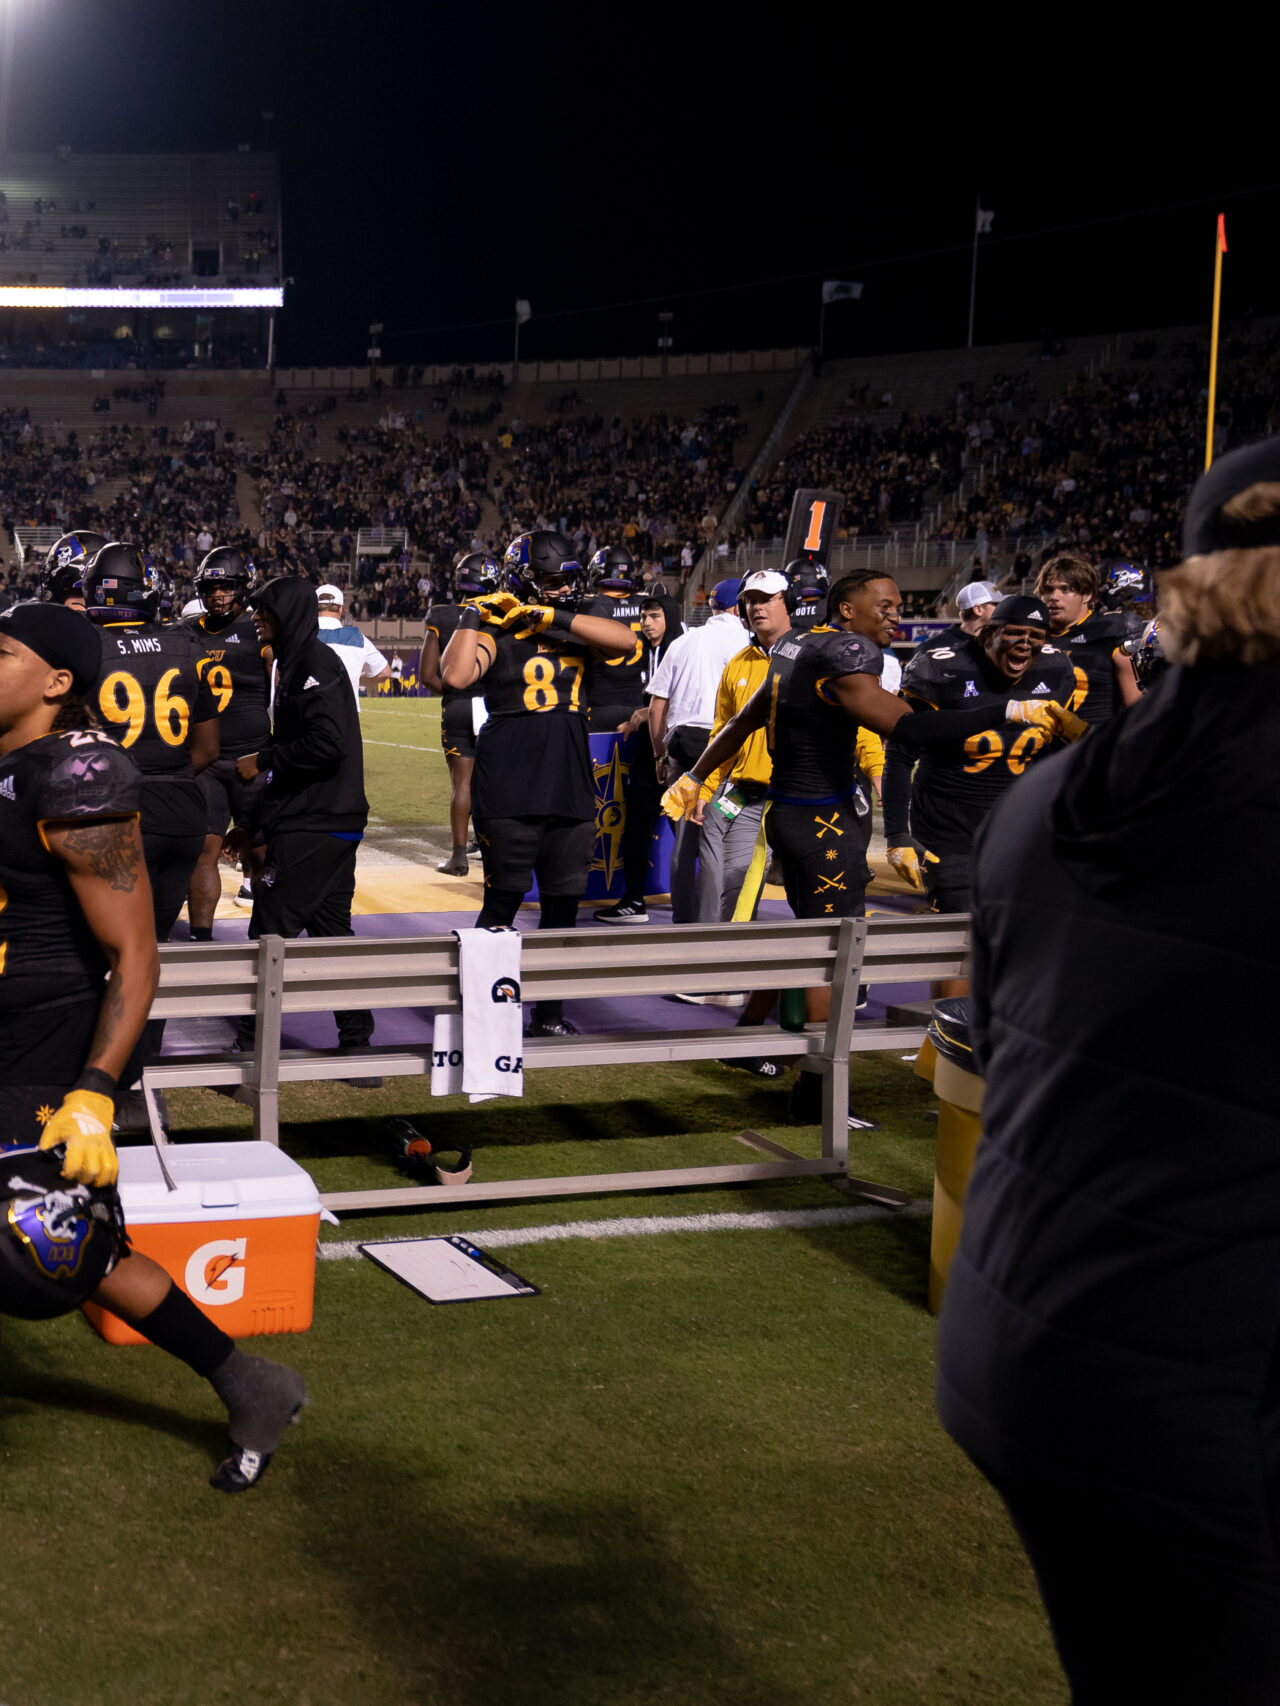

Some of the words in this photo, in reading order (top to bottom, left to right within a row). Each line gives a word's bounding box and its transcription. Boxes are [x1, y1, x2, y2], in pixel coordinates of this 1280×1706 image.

[803, 500, 827, 551] 1
[790, 605, 817, 617] OOTE
[116, 640, 131, 655] S.
[132, 637, 162, 654] MIMS
[522, 655, 585, 712] 87
[98, 666, 191, 749] 96
[431, 1050, 463, 1067] TO
